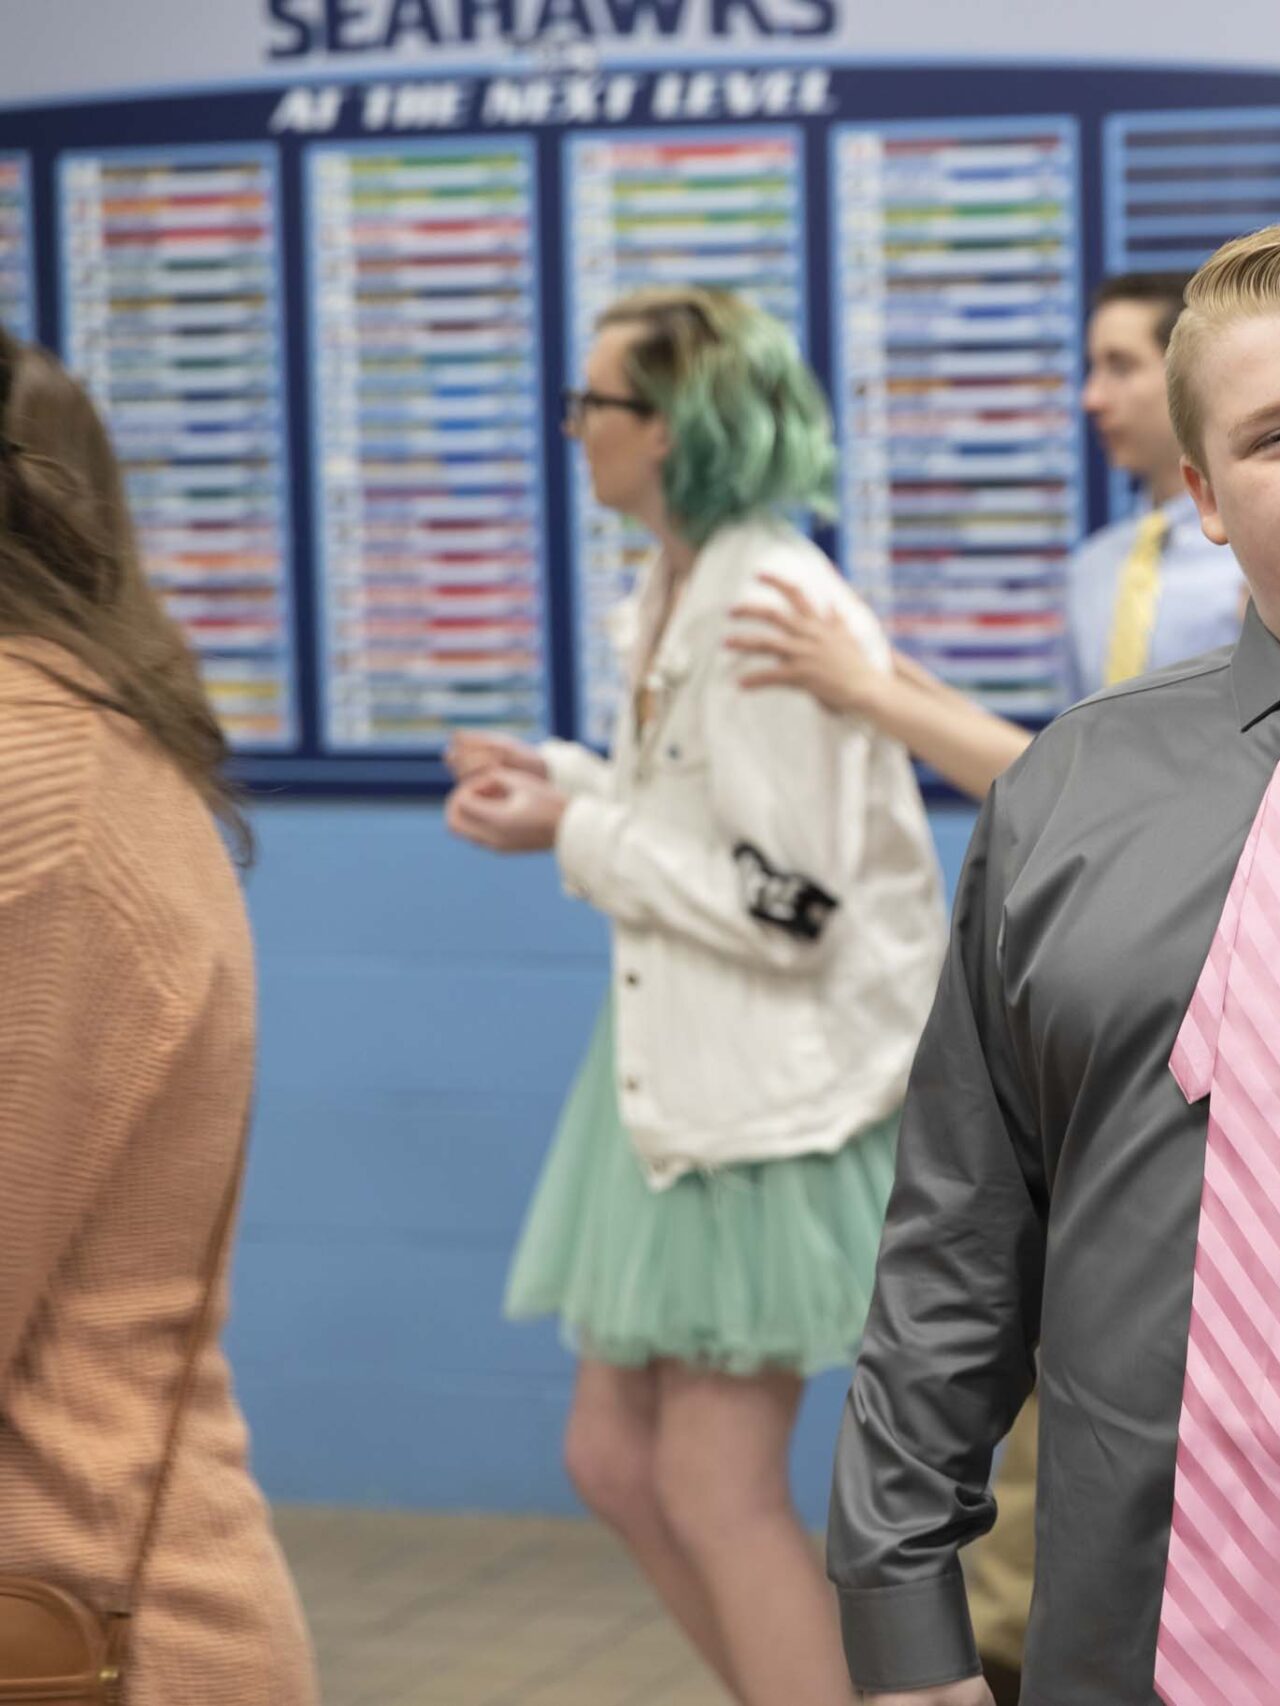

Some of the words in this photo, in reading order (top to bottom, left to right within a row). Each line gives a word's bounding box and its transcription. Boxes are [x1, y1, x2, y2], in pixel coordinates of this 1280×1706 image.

[268, 0, 837, 58] SEAHAWKS
[268, 84, 344, 132] AT
[360, 80, 470, 131] THE
[480, 74, 642, 127] NEXT
[650, 66, 836, 121] LEVEL
